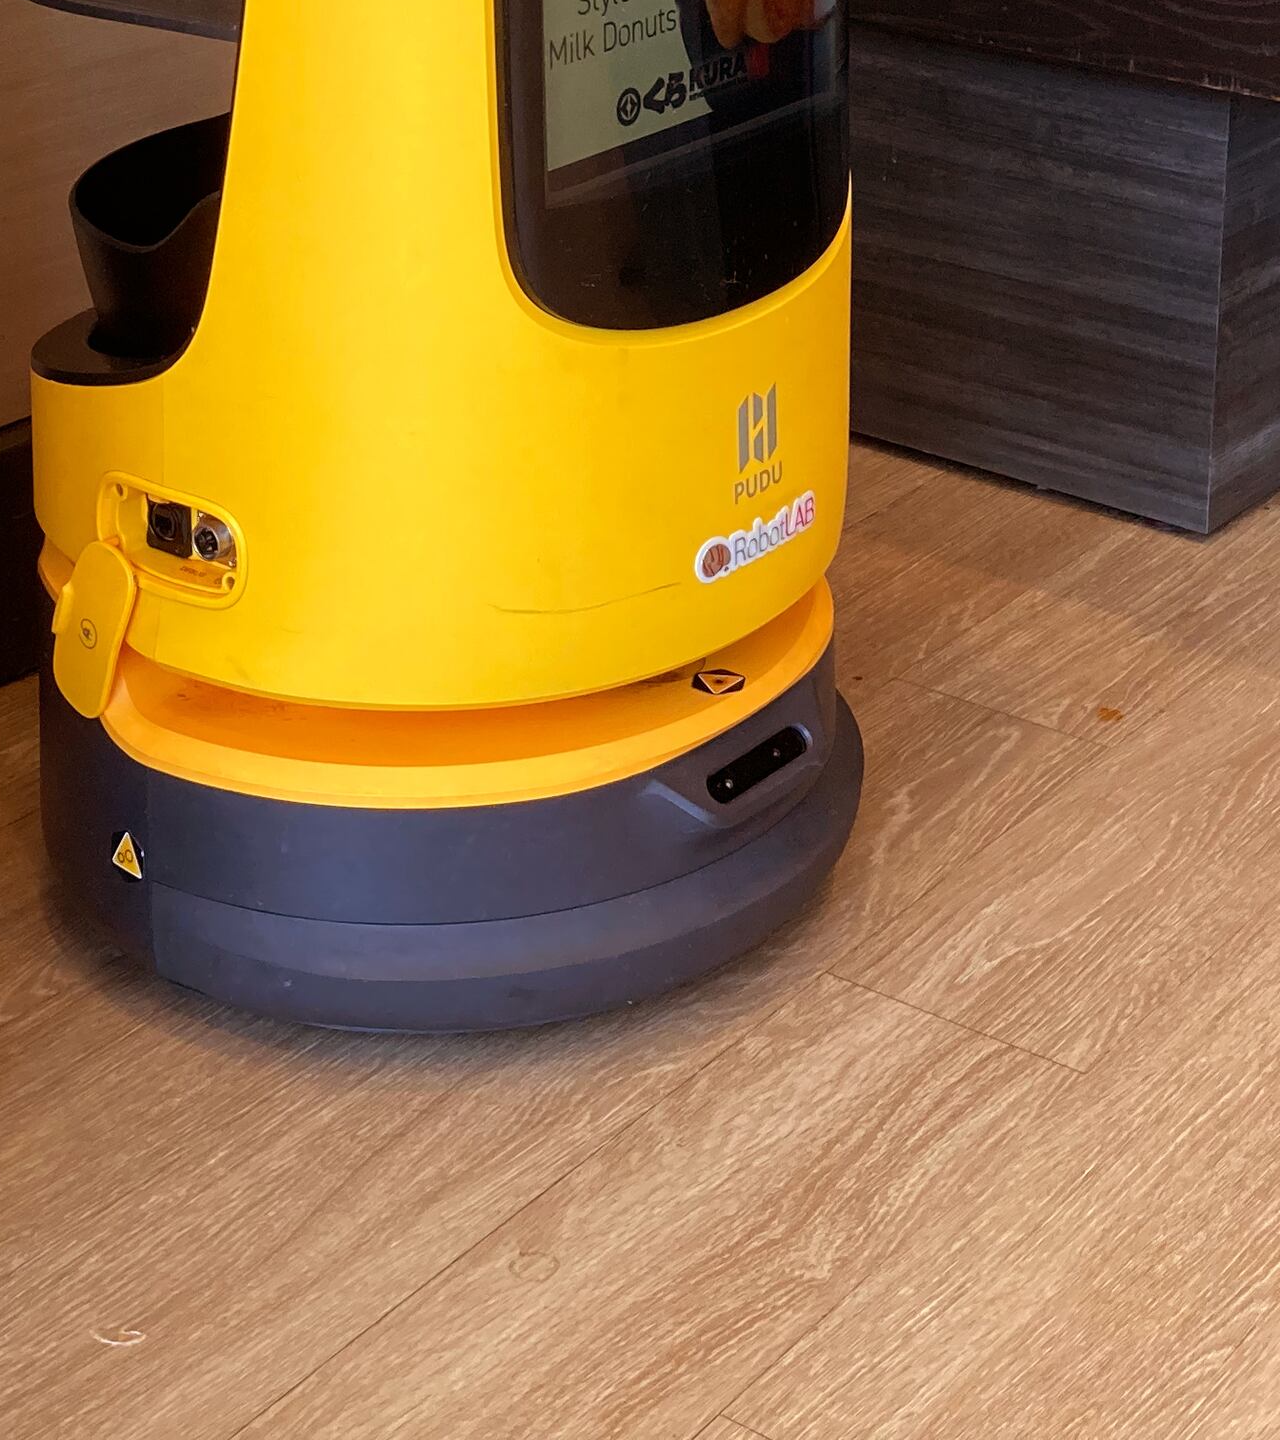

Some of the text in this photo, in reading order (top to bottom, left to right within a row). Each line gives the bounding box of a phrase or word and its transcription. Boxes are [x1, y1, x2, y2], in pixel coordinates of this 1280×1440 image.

[549, 8, 677, 70] Milk Donuts
[734, 460, 783, 505] PUDU
[734, 496, 815, 567] RobotLAB
